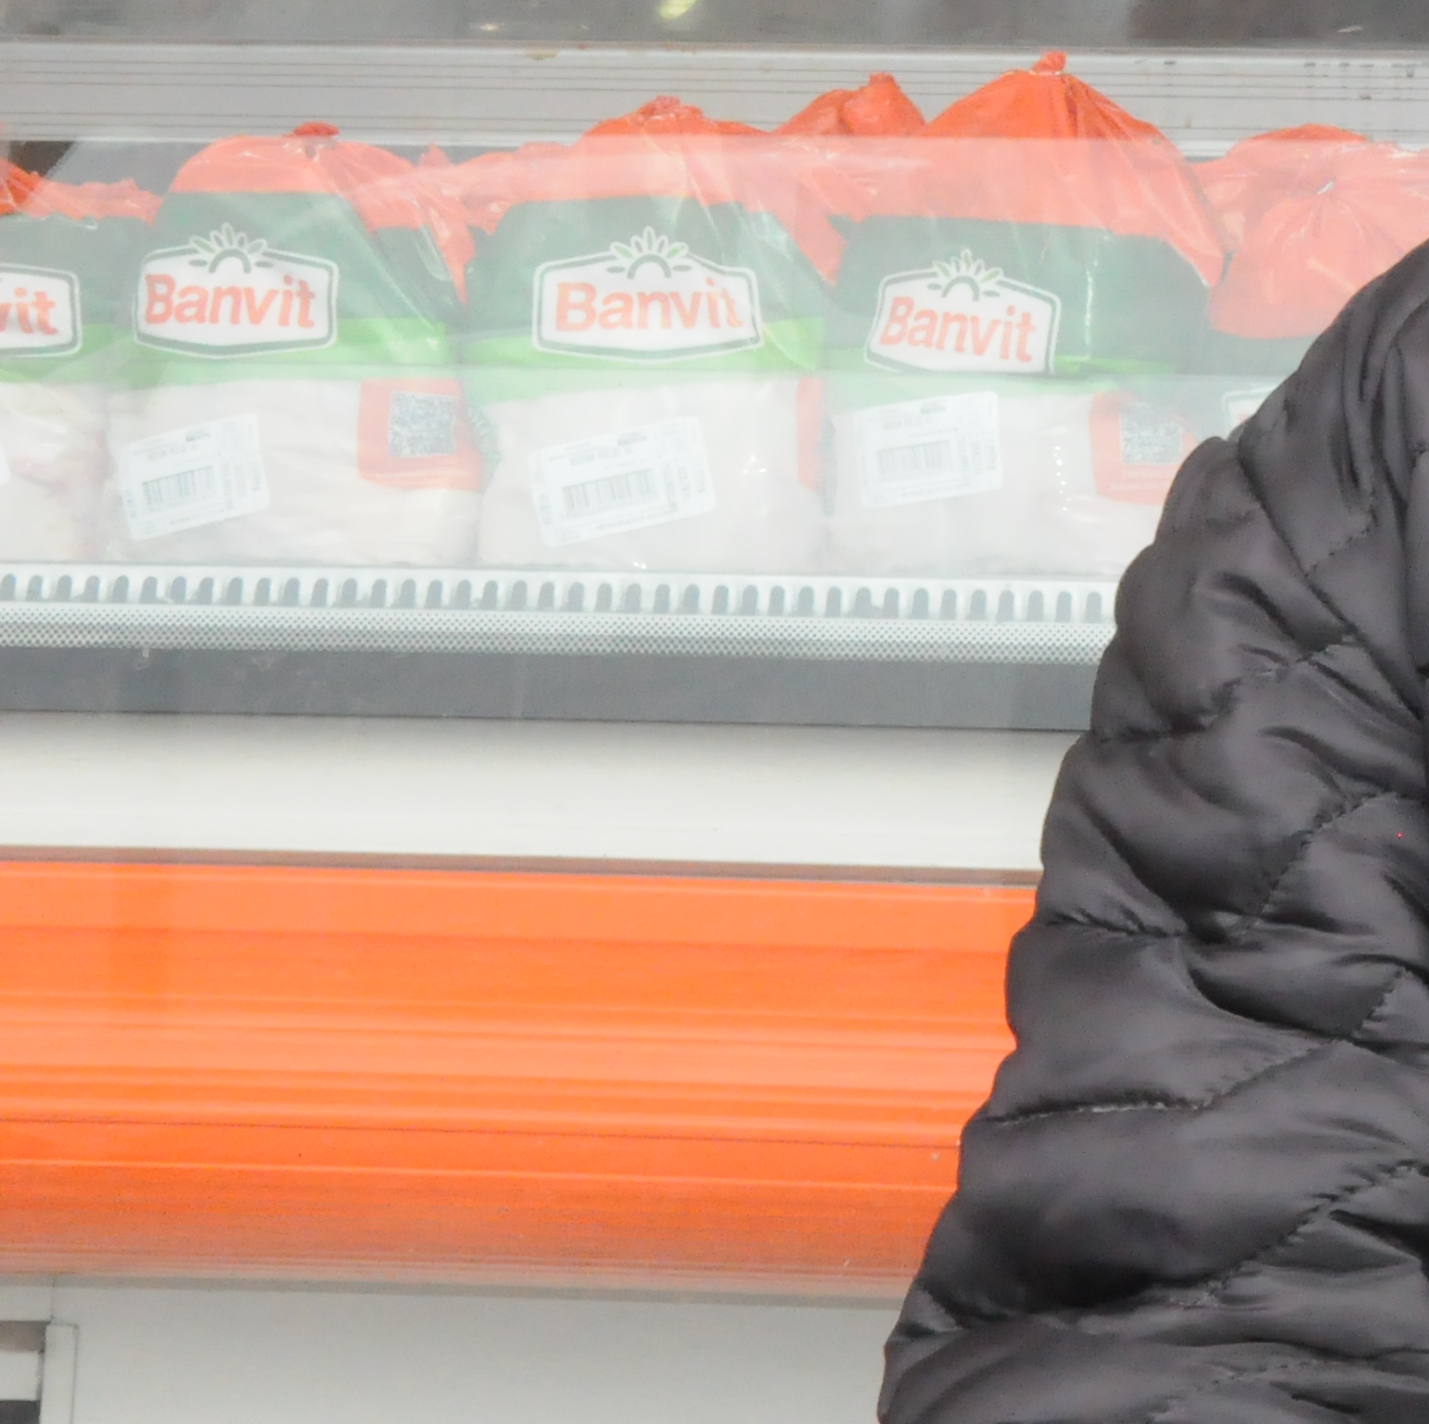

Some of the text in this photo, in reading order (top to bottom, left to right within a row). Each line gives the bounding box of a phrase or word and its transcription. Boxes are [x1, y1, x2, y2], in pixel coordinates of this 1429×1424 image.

[144, 272, 318, 329] Banvit
[554, 276, 744, 333] Banvit
[877, 294, 1037, 363] Banvit
